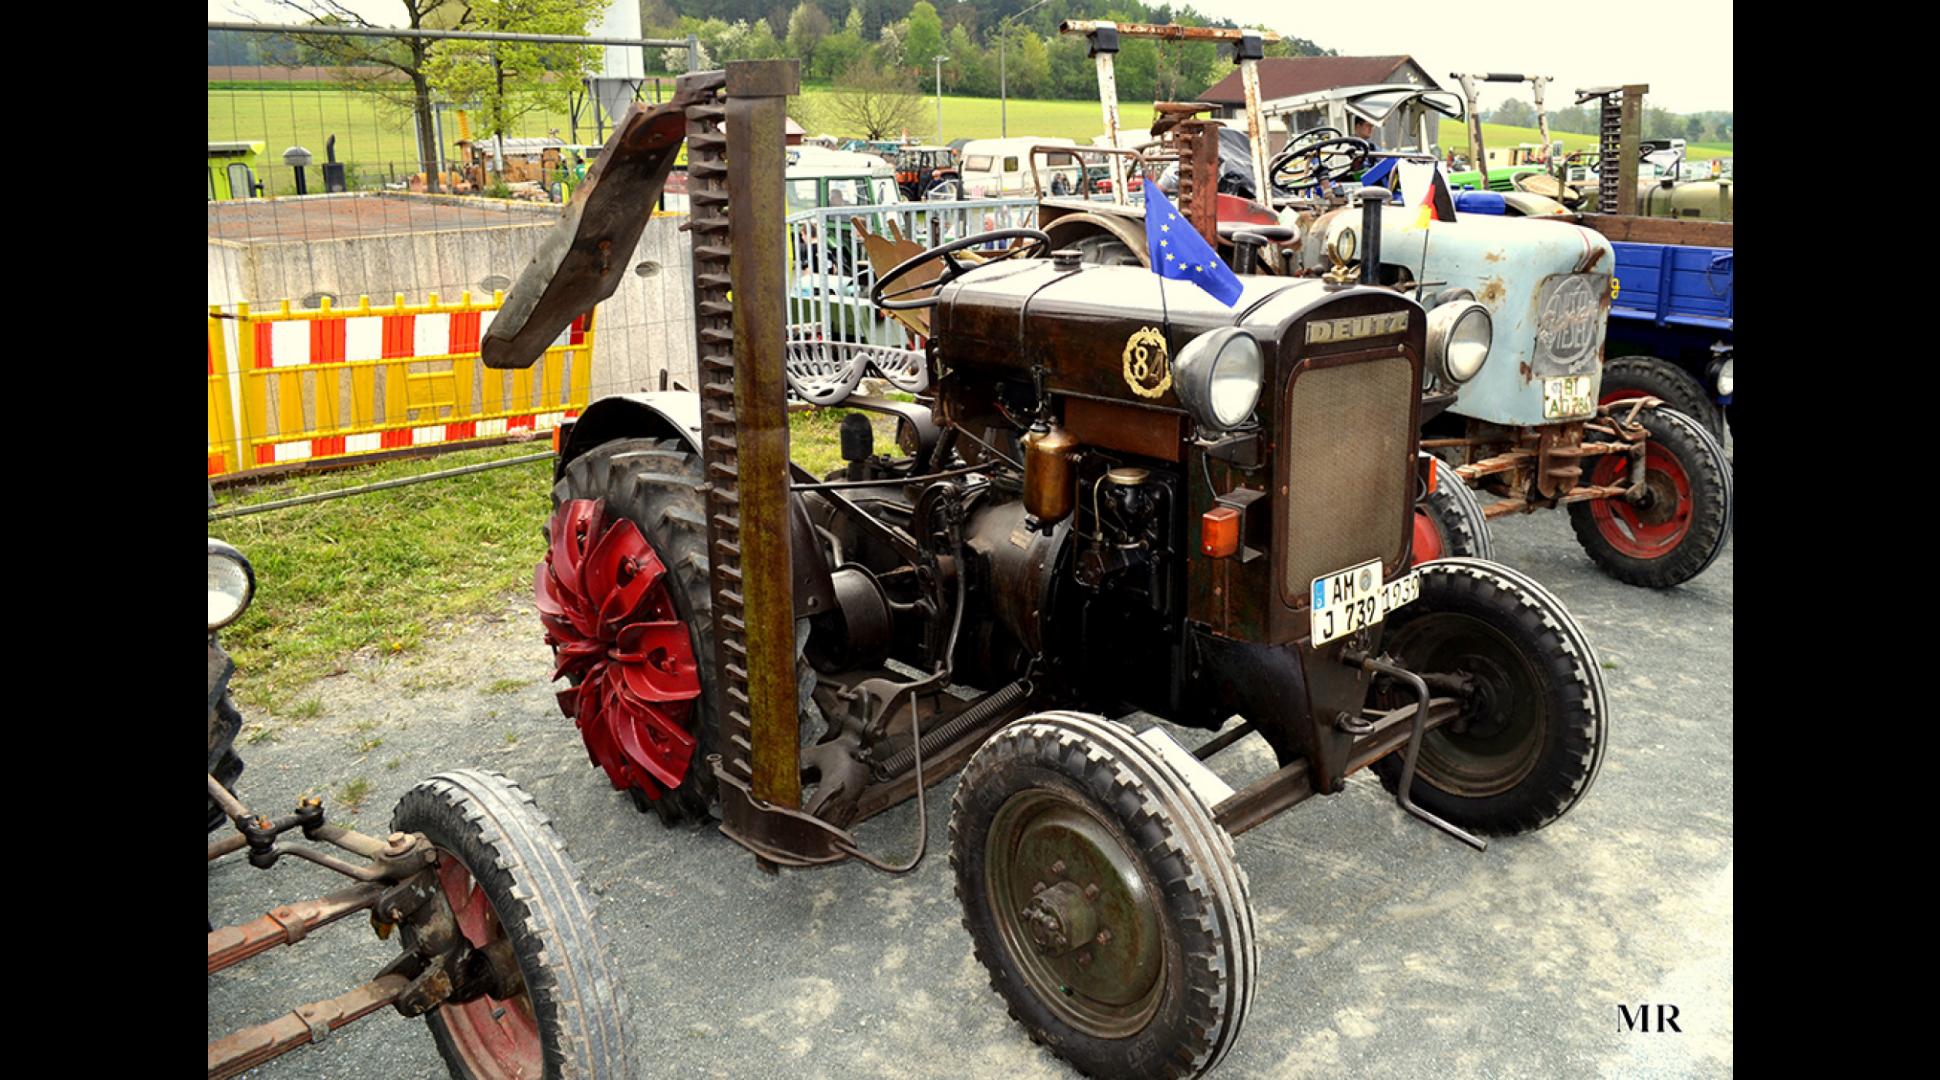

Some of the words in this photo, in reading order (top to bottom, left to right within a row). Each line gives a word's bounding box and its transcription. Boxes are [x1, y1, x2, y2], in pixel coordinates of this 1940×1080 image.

[1307, 311, 1409, 343] DEUTZ
[1332, 572, 1355, 604] AM
[1381, 575, 1419, 612] 1939
[1323, 611, 1334, 638] J
[1345, 596, 1375, 631] 739
